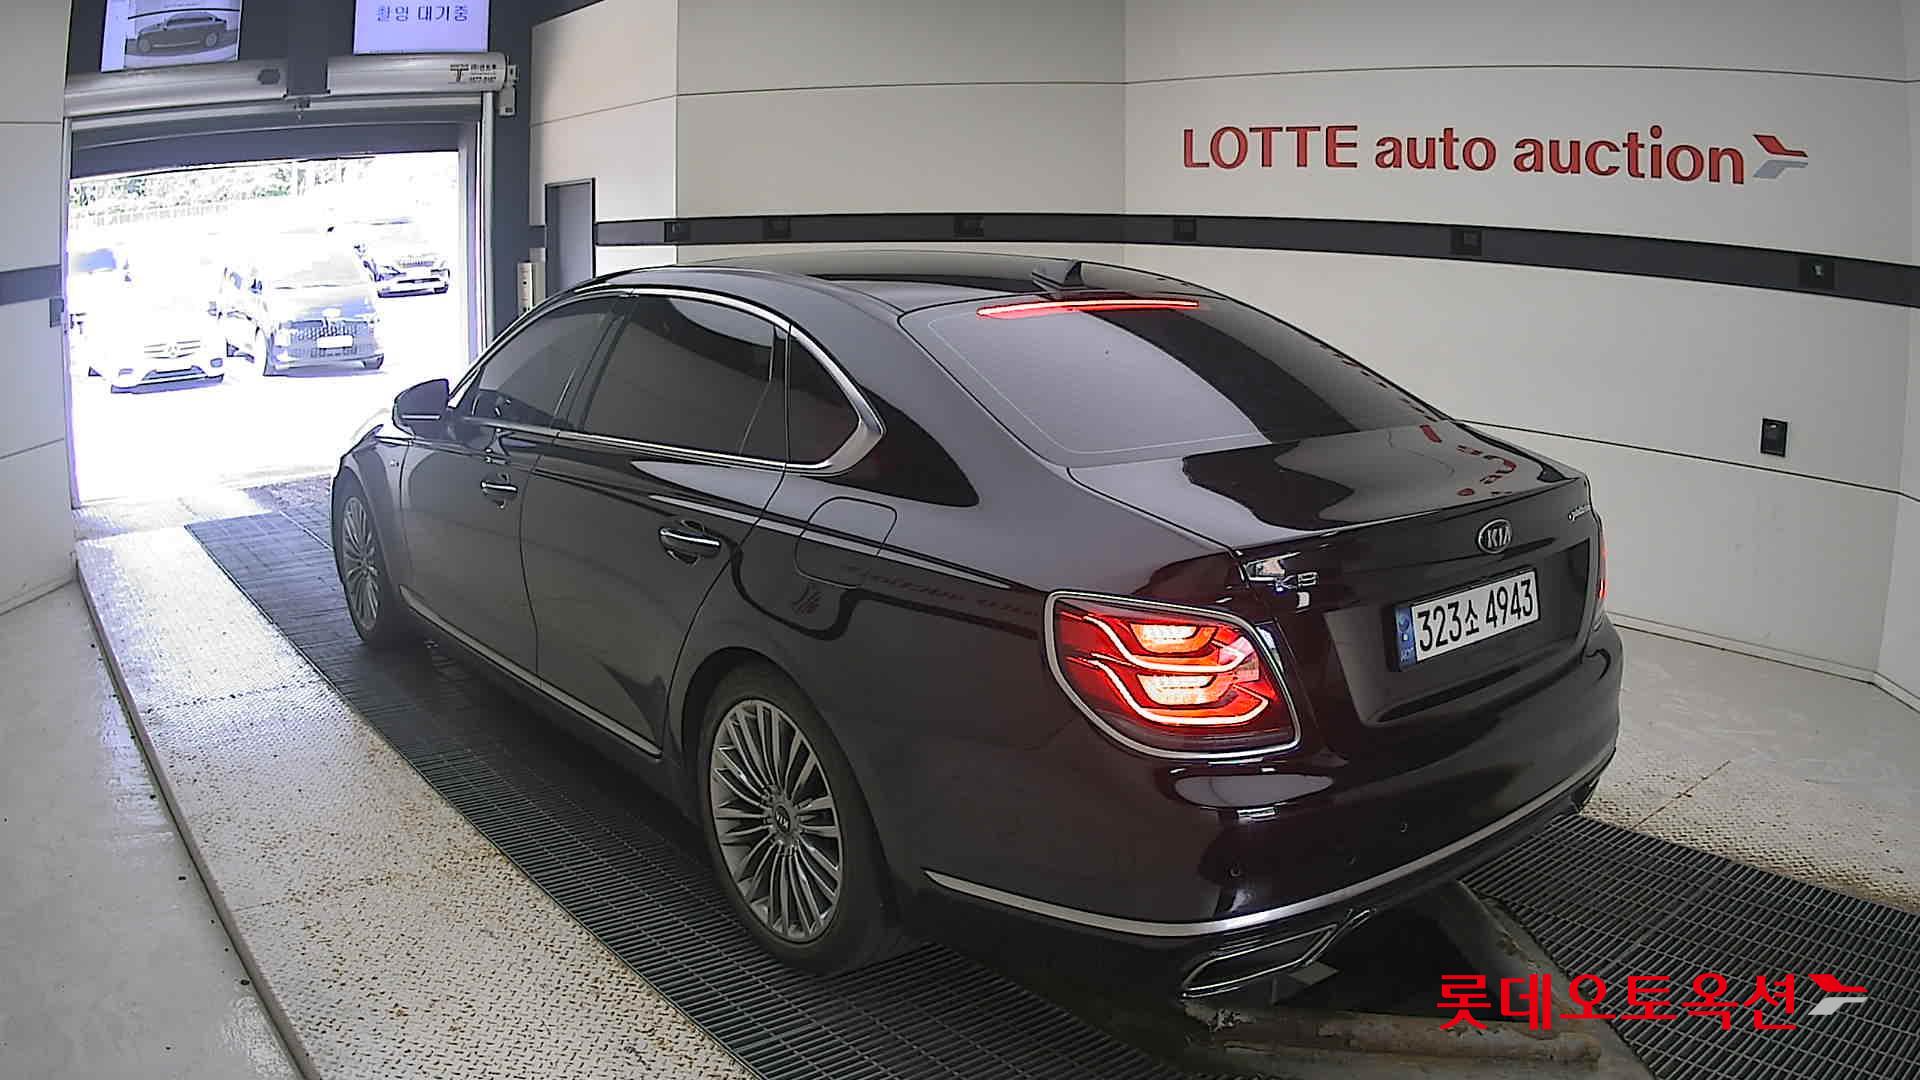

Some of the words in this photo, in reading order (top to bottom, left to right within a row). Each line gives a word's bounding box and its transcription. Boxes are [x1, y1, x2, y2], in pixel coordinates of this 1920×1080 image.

[418, 5, 468, 22] 대기중
[1183, 125, 1359, 169] LOTTE
[1375, 128, 1497, 171] auto
[1513, 125, 1745, 185] auction
[1486, 526, 1512, 549] KIA
[1417, 600, 1480, 651] 323소
[1485, 579, 1534, 628] 4943
